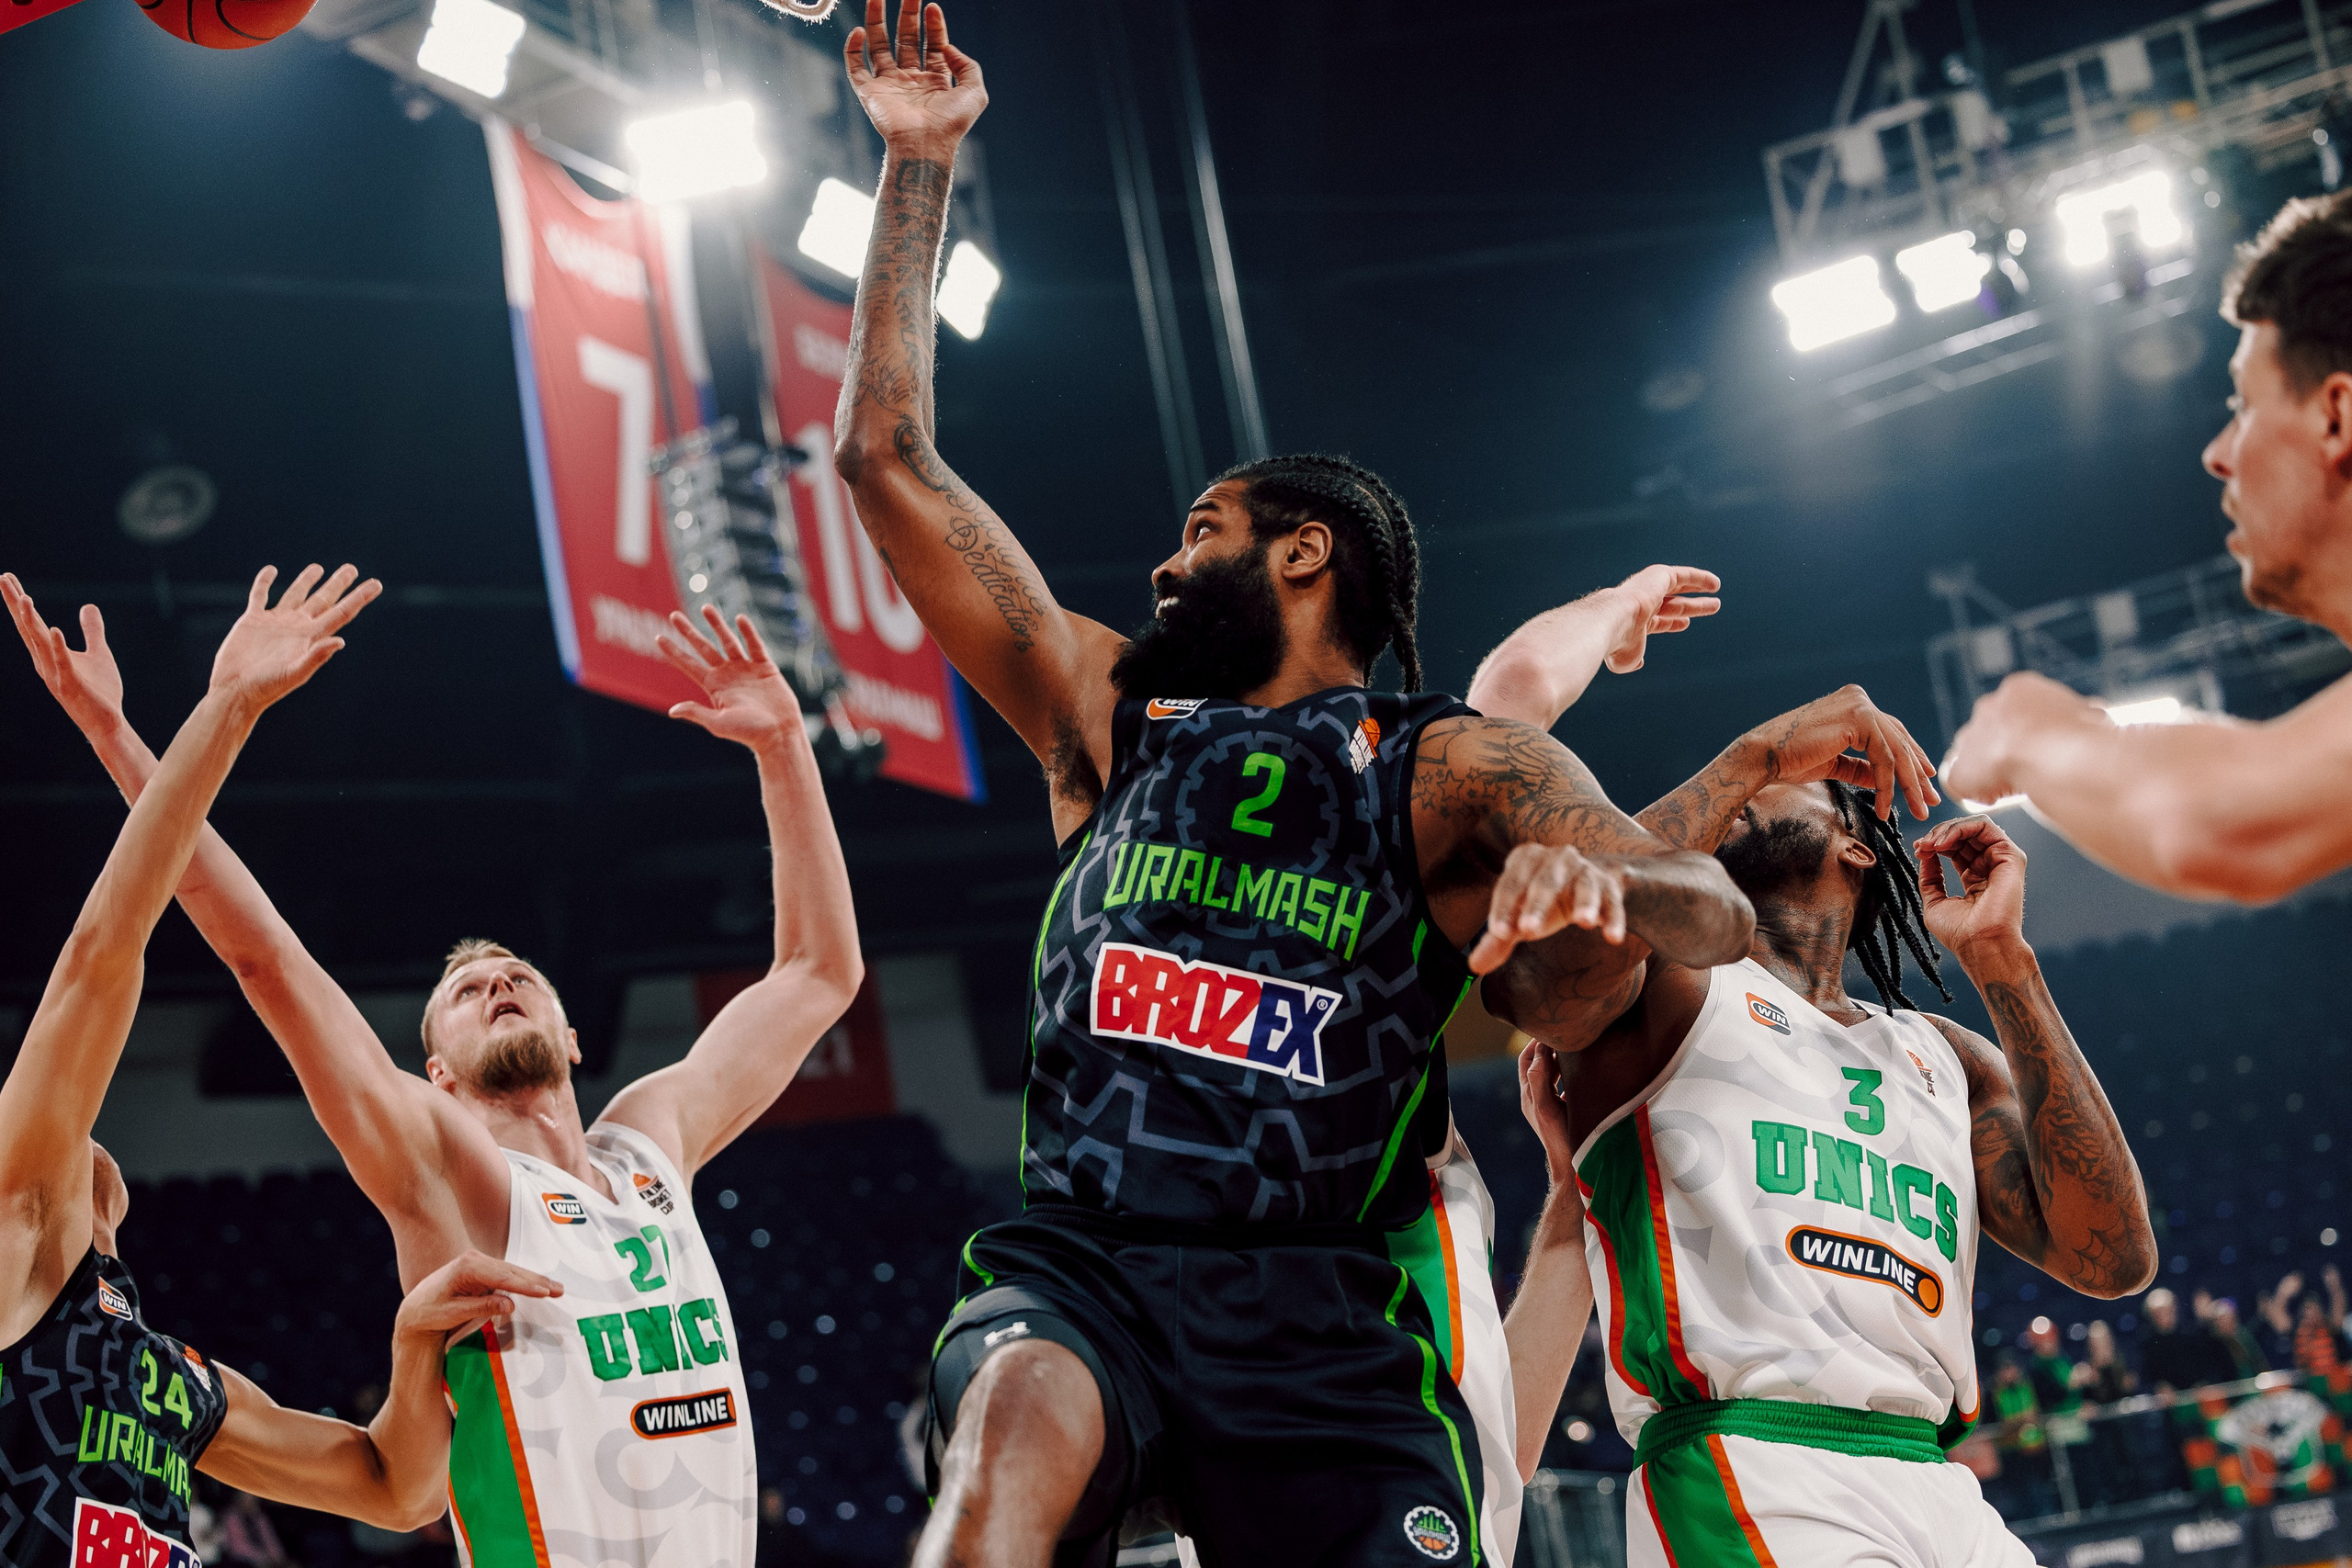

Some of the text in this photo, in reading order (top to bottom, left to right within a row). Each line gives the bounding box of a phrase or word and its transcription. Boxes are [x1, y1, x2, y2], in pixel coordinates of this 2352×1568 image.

[578, 333, 653, 568] 7
[1231, 751, 1286, 838] 2
[1103, 842, 1372, 962] URALMASH
[1758, 1005, 1786, 1025] WIN
[1840, 1066, 1885, 1135] 3
[554, 1202, 582, 1215] WIN
[1751, 1120, 1958, 1264] UNICS
[614, 1224, 672, 1292] 27
[1802, 1235, 1917, 1294] WINLINE
[102, 1292, 127, 1312] WIN
[141, 1348, 193, 1430] 24
[643, 1396, 729, 1431] WINLINE
